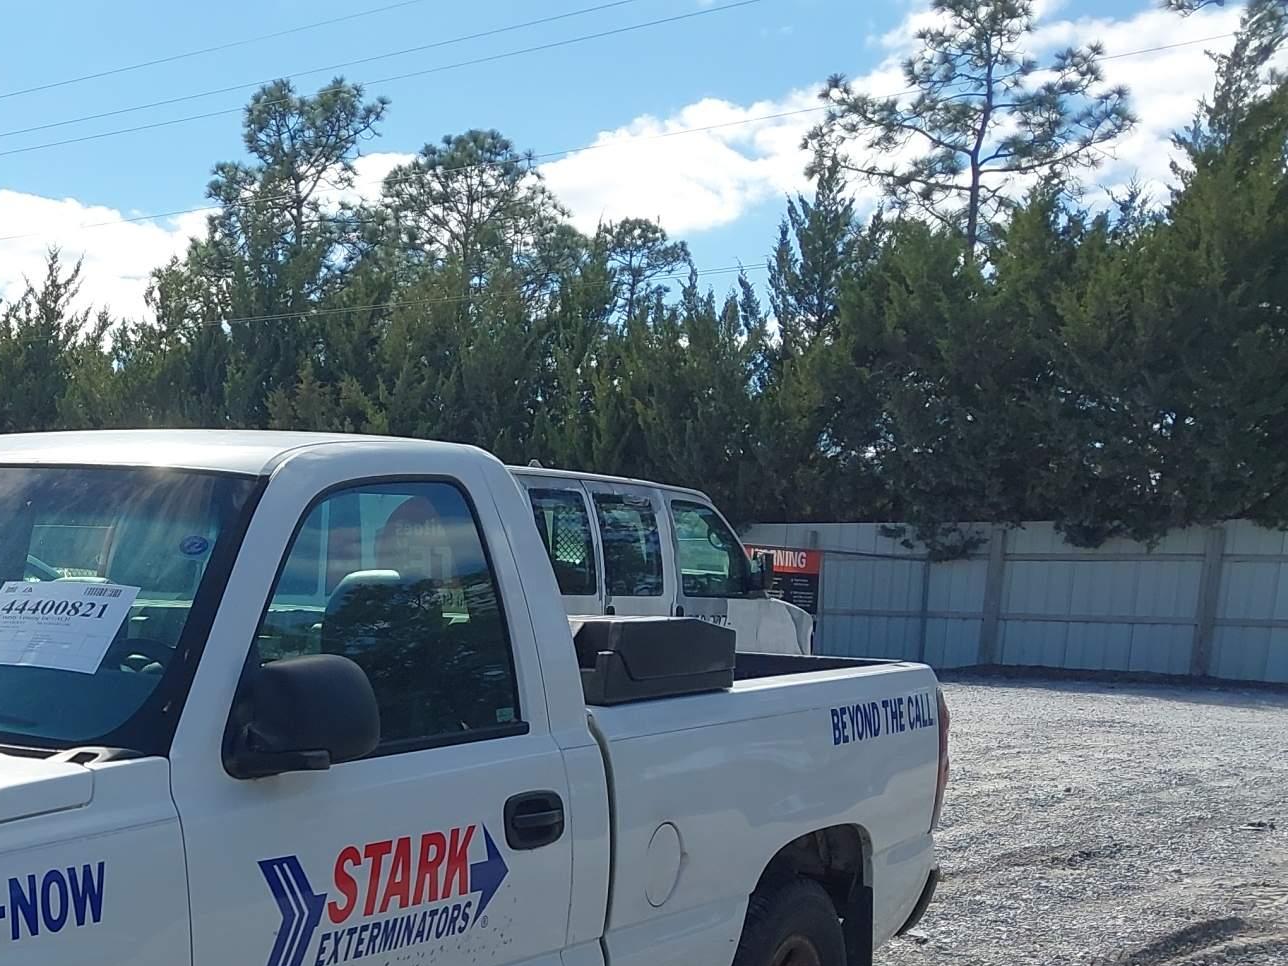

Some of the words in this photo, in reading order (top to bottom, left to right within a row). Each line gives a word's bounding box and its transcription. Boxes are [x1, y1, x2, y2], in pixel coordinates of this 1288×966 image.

[751, 547, 807, 569] NING
[1, 599, 109, 619] 44400821
[830, 701, 880, 745] BEYOND
[882, 697, 906, 735] THE
[907, 693, 934, 731] CALL
[327, 823, 477, 925] STARK
